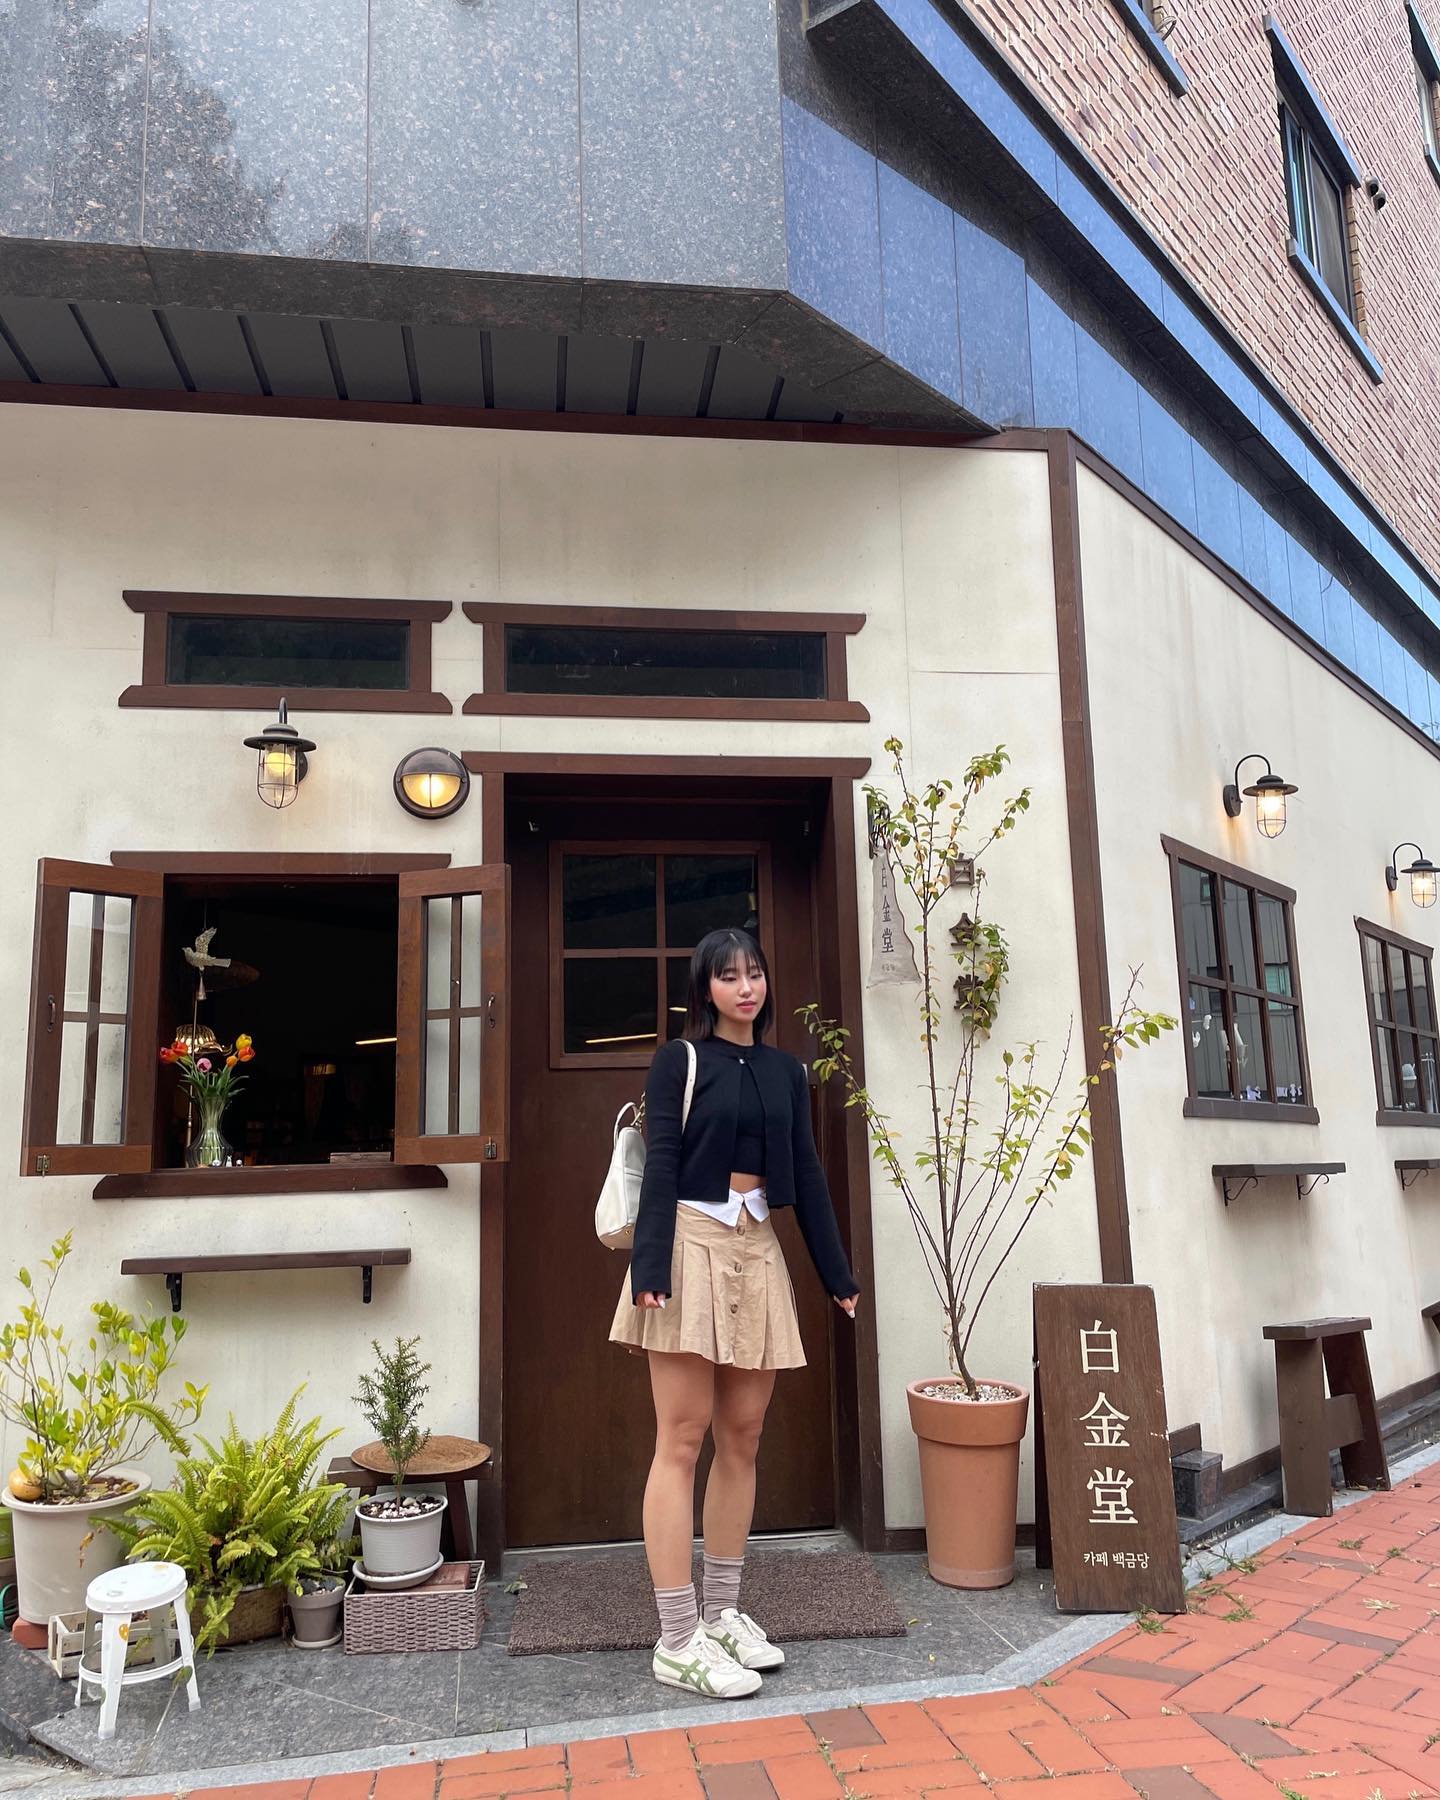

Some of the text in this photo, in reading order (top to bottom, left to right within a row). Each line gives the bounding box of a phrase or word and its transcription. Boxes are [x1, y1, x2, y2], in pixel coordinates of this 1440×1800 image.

[1079, 1320, 1138, 1524] 白金堂
[1083, 1551, 1150, 1569] 카페 백금당
